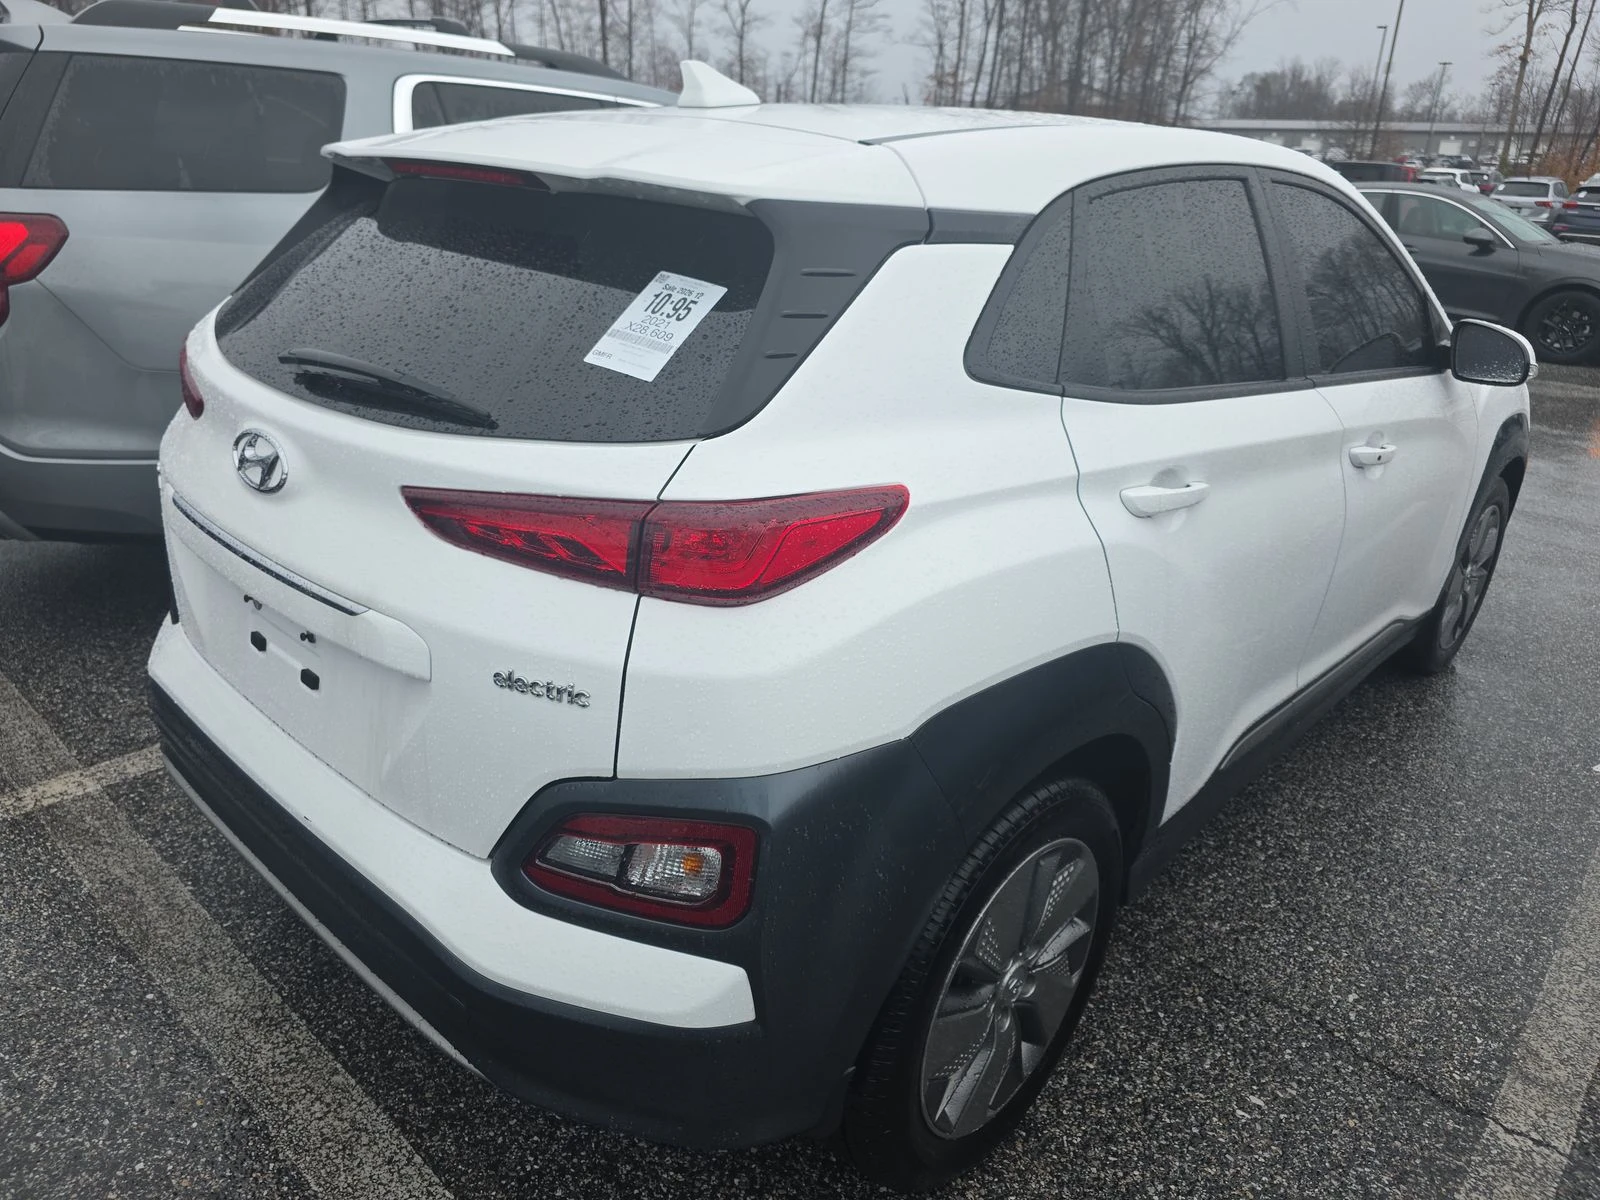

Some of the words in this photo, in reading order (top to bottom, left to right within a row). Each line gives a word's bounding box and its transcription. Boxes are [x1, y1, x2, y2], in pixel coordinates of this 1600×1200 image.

[641, 315, 672, 329] 2021
[644, 291, 699, 322] 10:95
[493, 669, 590, 707] electric
